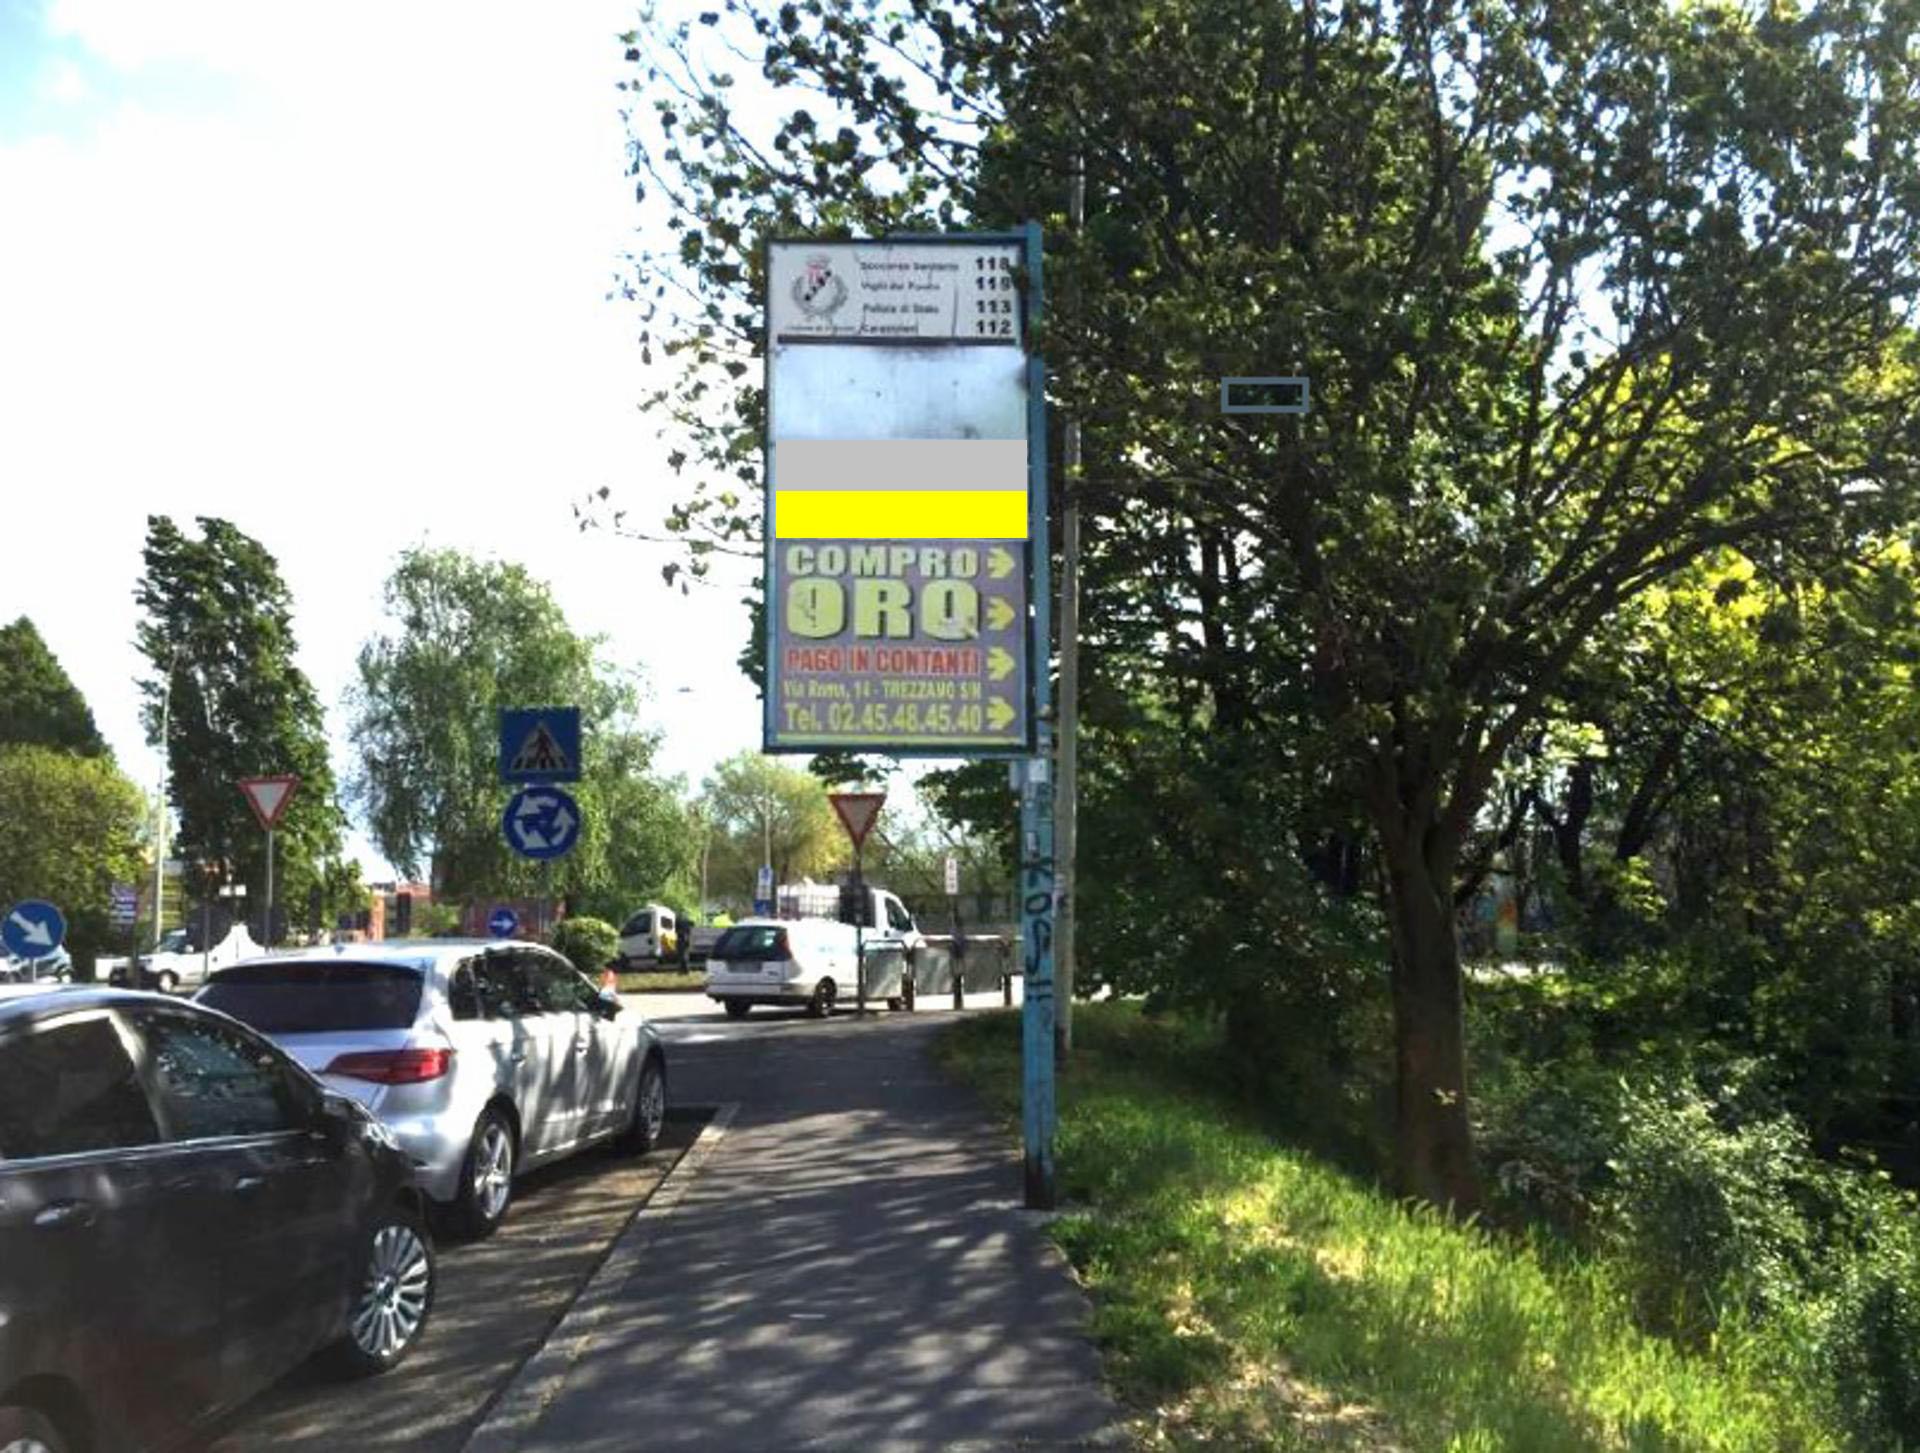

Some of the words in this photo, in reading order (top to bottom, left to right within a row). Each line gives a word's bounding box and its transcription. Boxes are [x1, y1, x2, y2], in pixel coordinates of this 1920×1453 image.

[975, 256, 1011, 271] 118
[975, 276, 1012, 291] 119
[976, 300, 1012, 314] 113
[975, 319, 1012, 335] 112
[786, 544, 980, 579] COMPRO
[786, 577, 981, 641] ORO
[785, 648, 843, 673] PAGO
[849, 648, 870, 674] IN
[875, 648, 981, 675] CONTANTI
[785, 701, 823, 732] Tel.
[827, 701, 983, 733] 02.45.48.45.40
